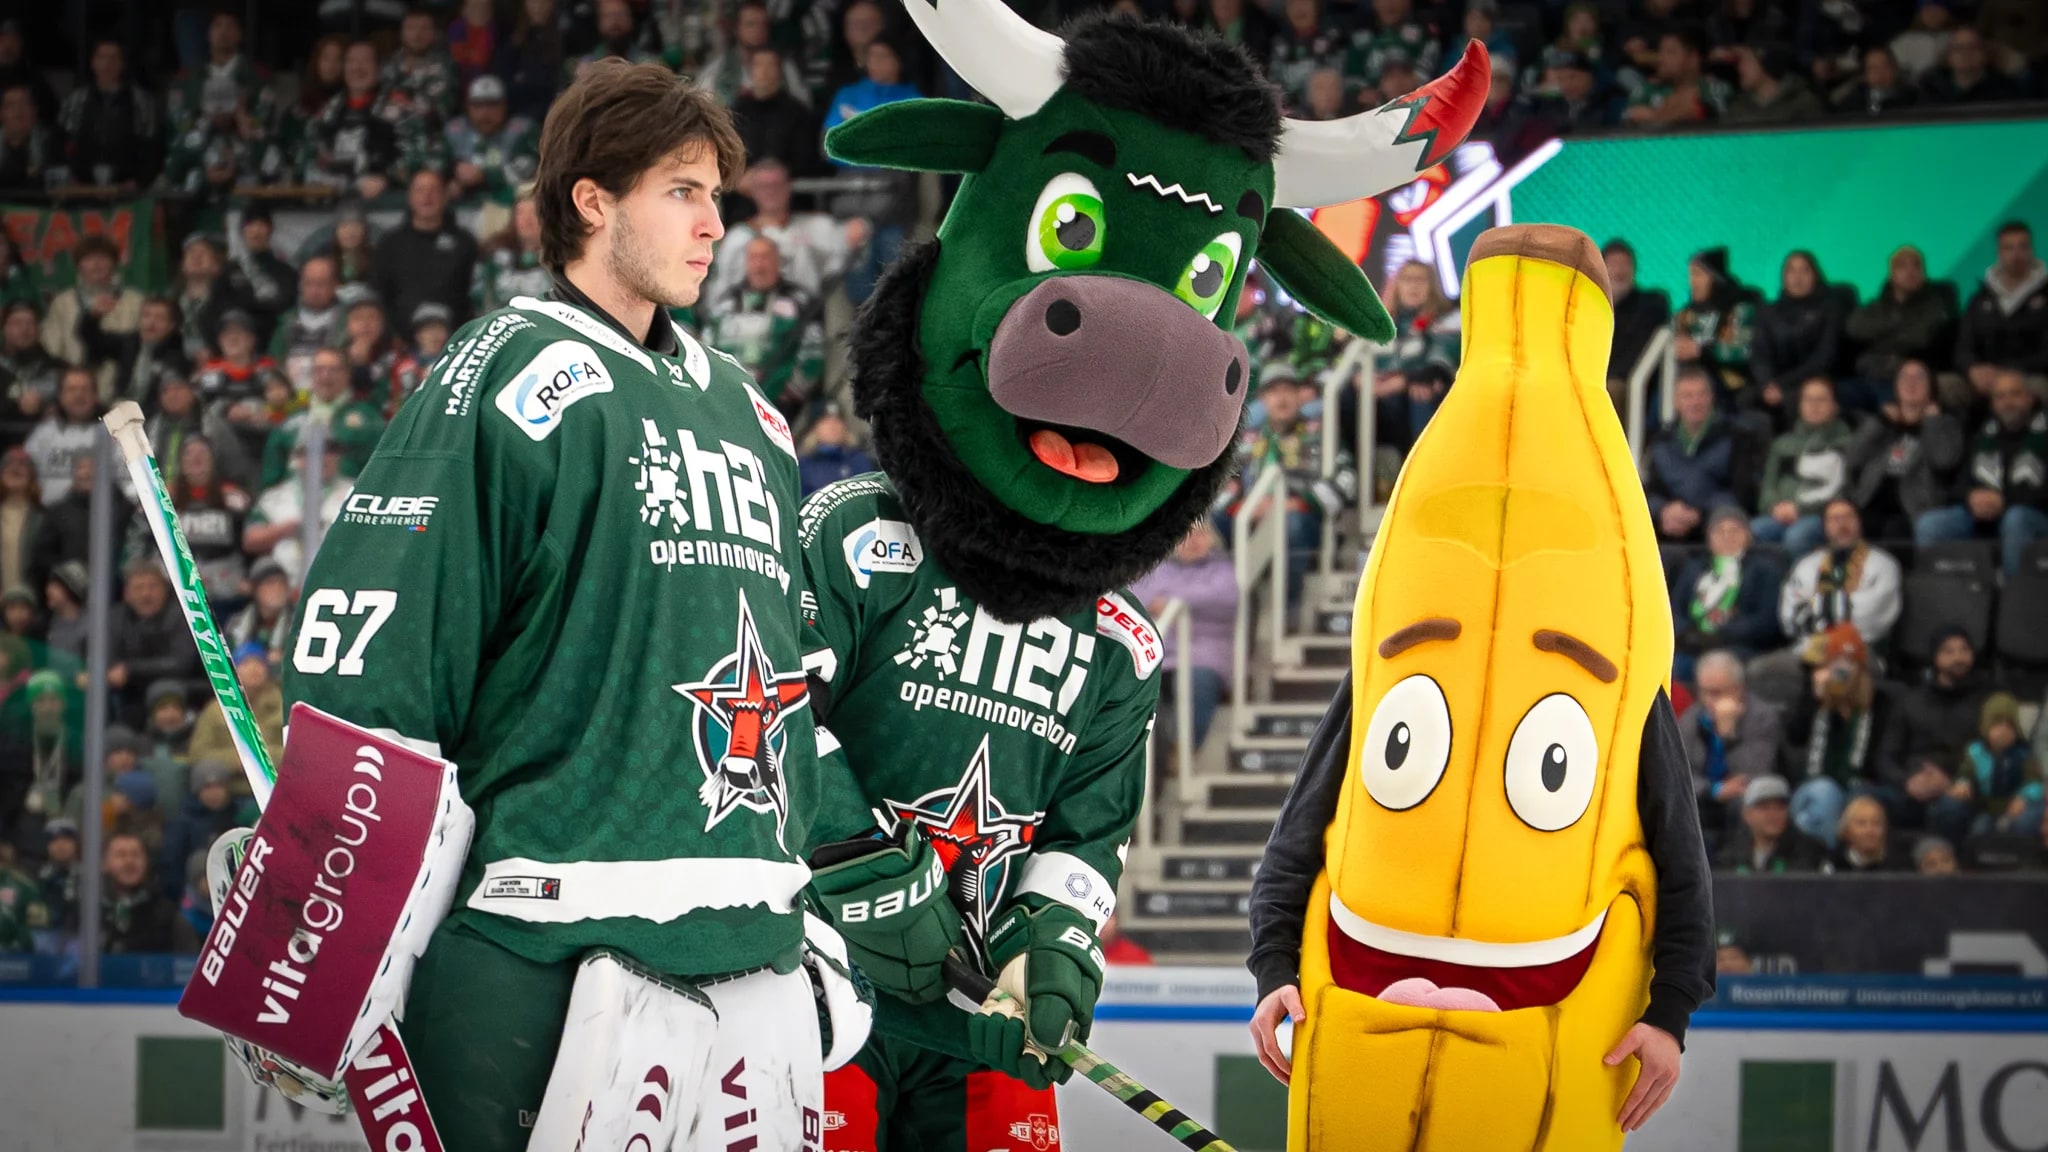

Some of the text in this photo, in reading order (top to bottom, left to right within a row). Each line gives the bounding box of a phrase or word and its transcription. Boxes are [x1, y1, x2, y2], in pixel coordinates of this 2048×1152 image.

[537, 362, 601, 410] ROFA
[344, 513, 378, 525] STORE
[345, 494, 439, 515] CUBE
[871, 540, 916, 561] OFA
[293, 589, 397, 676] 67
[257, 781, 382, 1025] vitagroup
